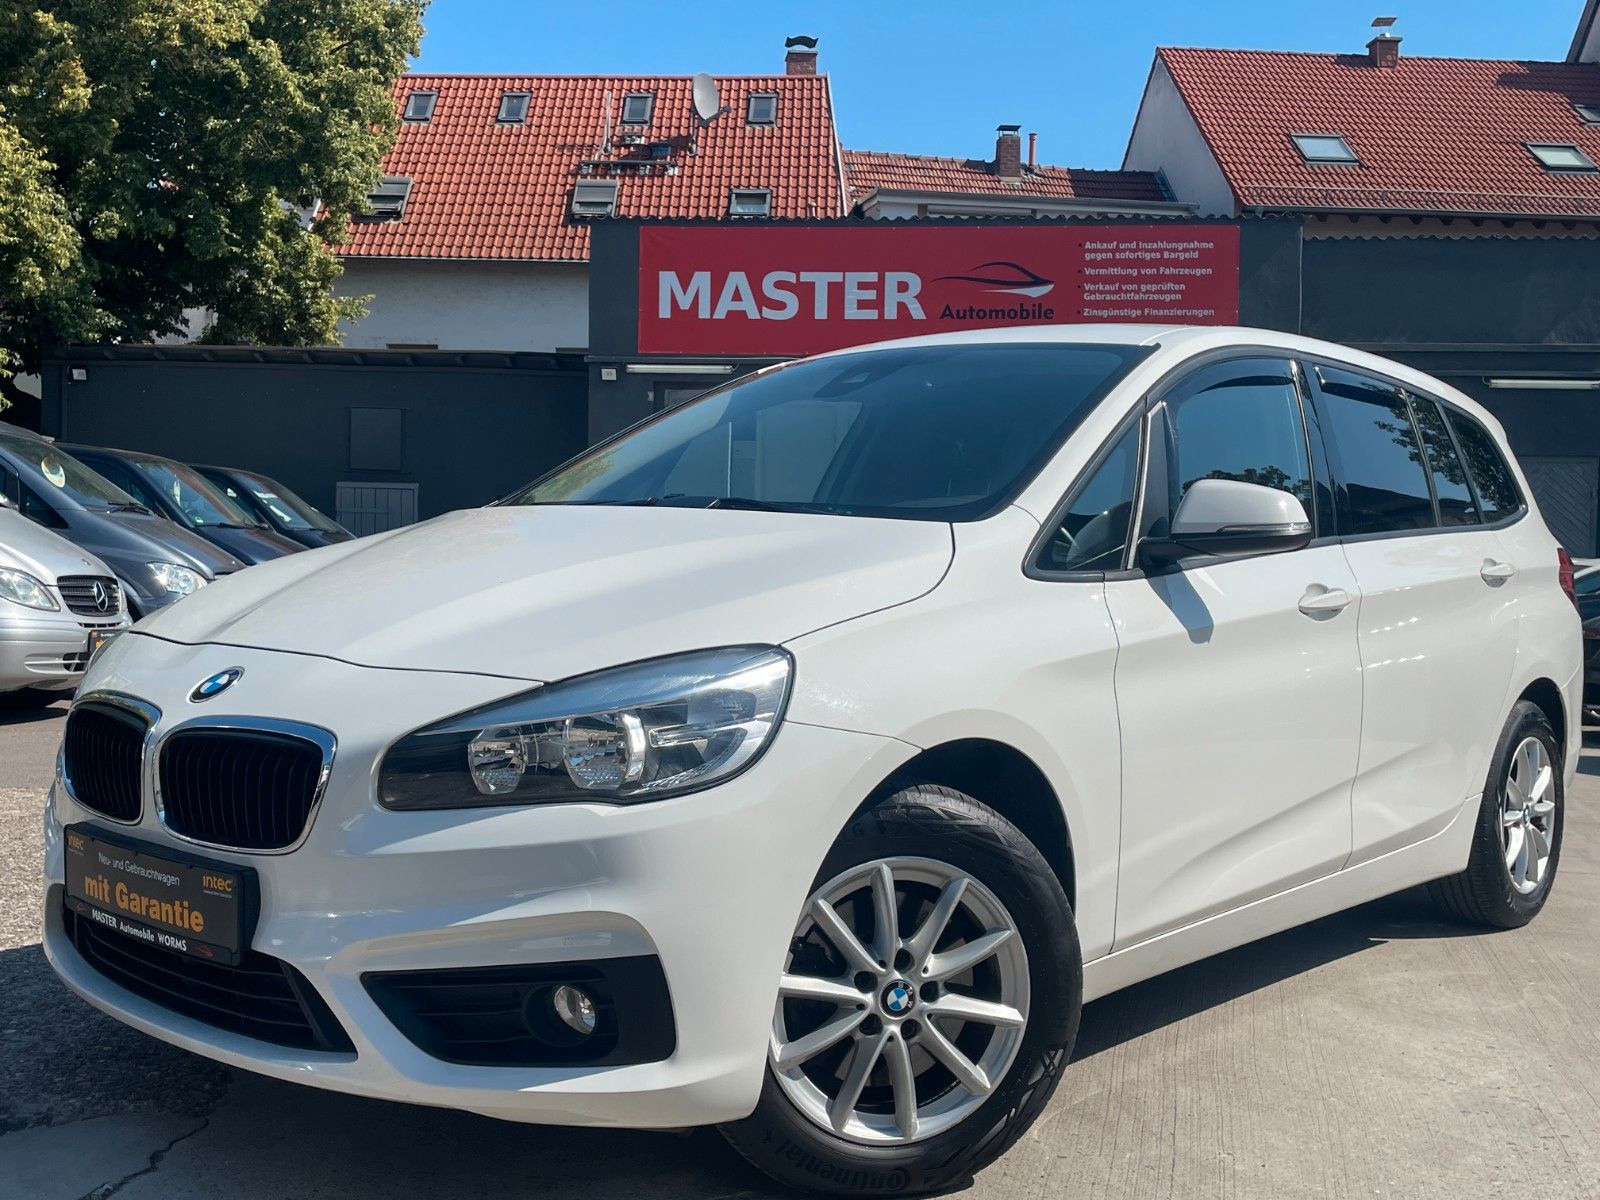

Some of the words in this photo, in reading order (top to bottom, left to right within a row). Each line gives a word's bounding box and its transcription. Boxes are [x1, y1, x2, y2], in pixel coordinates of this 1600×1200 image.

[1084, 241, 1117, 250] Ankauf
[1119, 241, 1137, 250] und
[1139, 241, 1214, 251] Inzahlungnahme
[1085, 252, 1113, 261] gegen
[1115, 251, 1161, 261] sofortiges
[1163, 251, 1199, 261] Bargeld
[1084, 267, 1138, 277] Vermittlung
[1160, 267, 1213, 277] Fahrzeugen
[1084, 282, 1120, 291] Verkauf
[1140, 282, 1186, 292] geprüften
[658, 270, 927, 321] MASTER
[1083, 292, 1182, 302] Gebrauchtfahrzeugen
[940, 303, 1055, 320] Automobile
[1083, 307, 1142, 318] Zinsgünstige
[1144, 308, 1215, 318] Finanzierungen
[98, 851, 111, 866] Neu-
[112, 856, 124, 870] und
[125, 861, 180, 886] Gebrauchtwagen
[84, 874, 110, 904] mit
[115, 881, 205, 933] Garantie
[92, 908, 117, 929] MASTER
[119, 920, 155, 942] Automobile
[157, 931, 187, 952] WORMS
